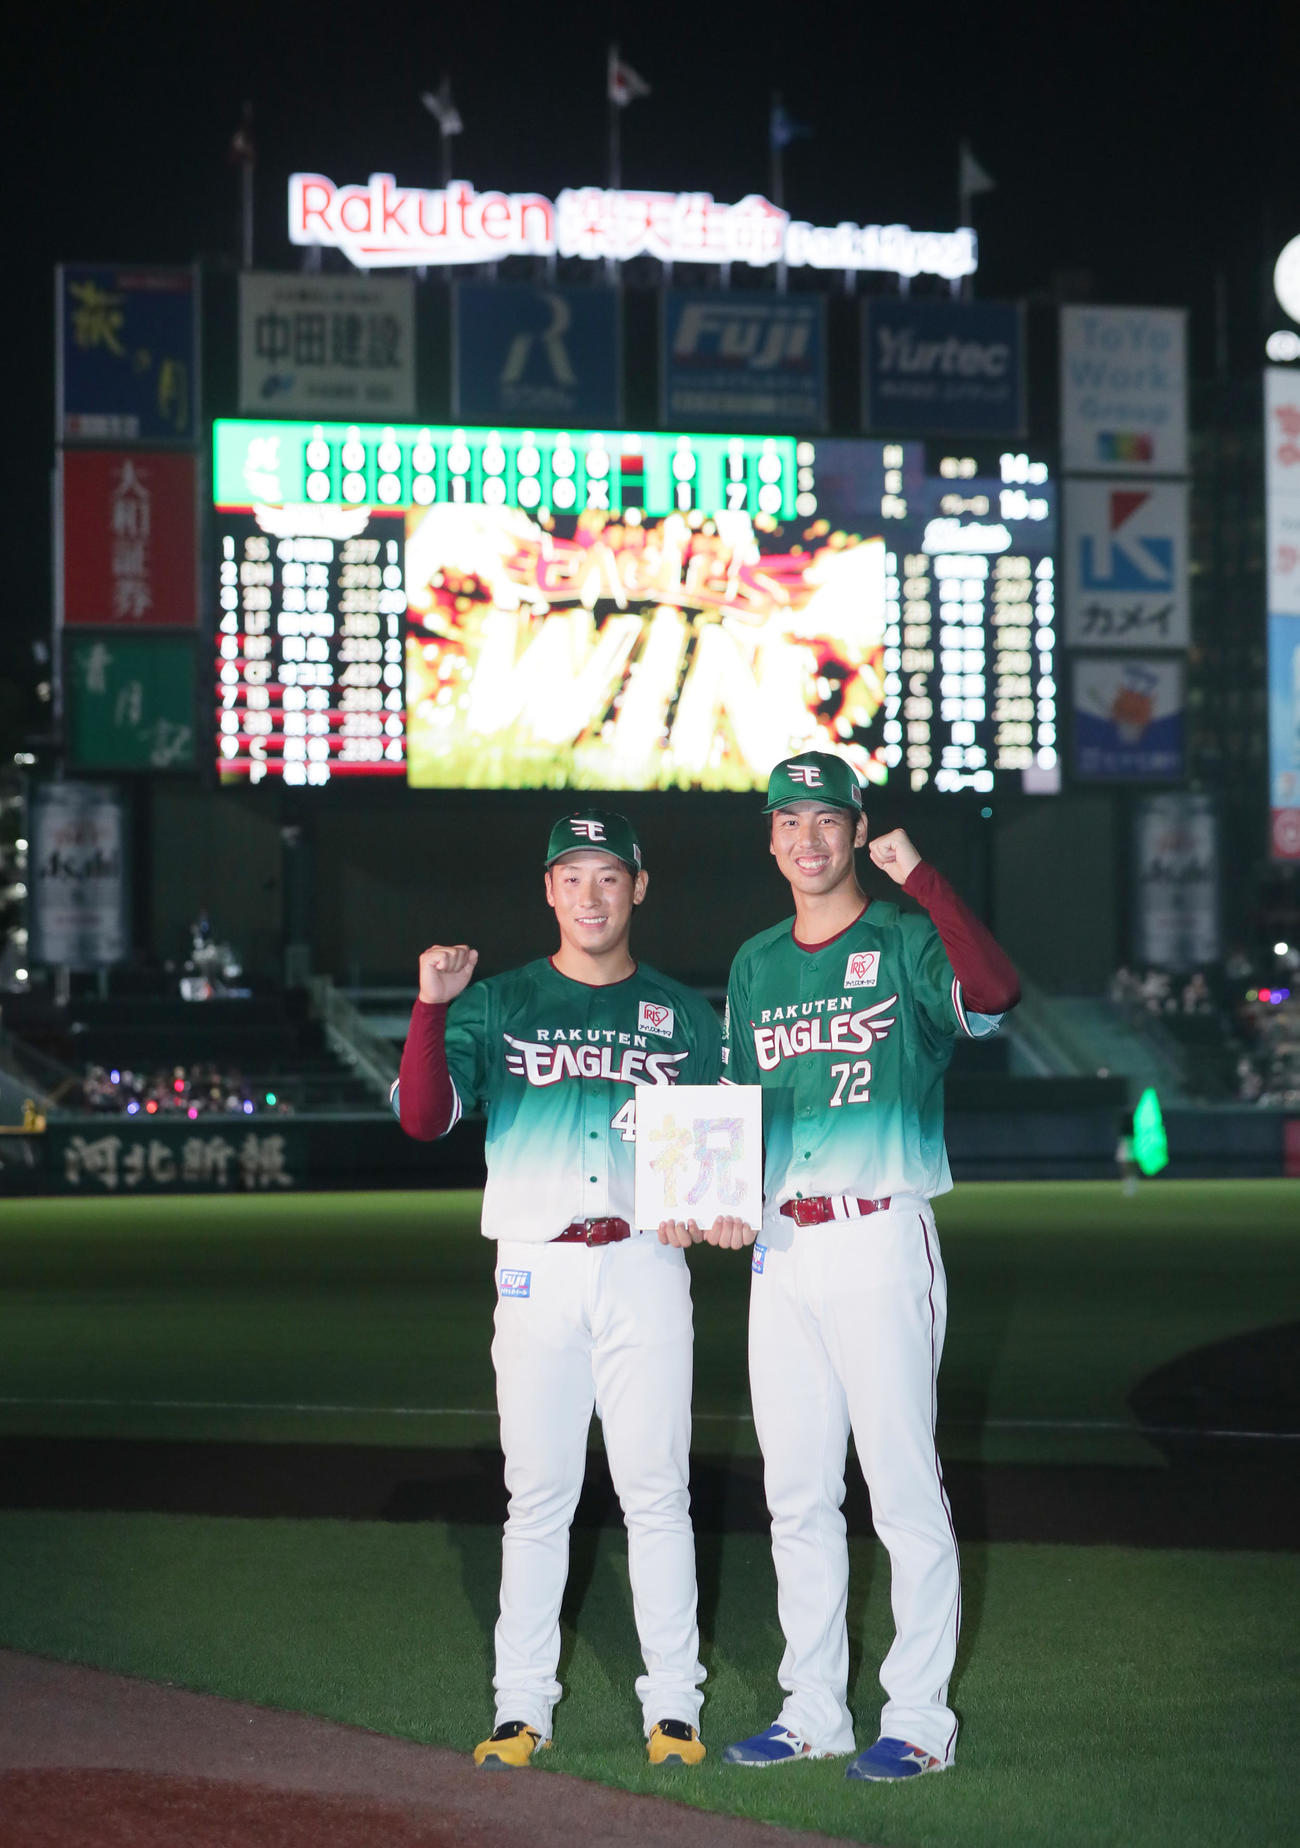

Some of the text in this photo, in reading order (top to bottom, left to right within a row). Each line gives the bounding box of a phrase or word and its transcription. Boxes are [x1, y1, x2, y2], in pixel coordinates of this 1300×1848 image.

[292, 174, 554, 248] Rakuten
[673, 304, 812, 369] Fuji
[878, 325, 1009, 376] Yurtec
[1070, 357, 1169, 391] Work
[1080, 603, 1175, 636] カメイ
[751, 993, 899, 1071] EAGLES
[761, 996, 853, 1024] RAKUTEN
[503, 1033, 689, 1087] EAGLES
[536, 1028, 647, 1048] RAKUTEN
[829, 1059, 873, 1107] 72
[649, 1114, 748, 1208] 祝
[501, 1270, 529, 1289] Fuji
